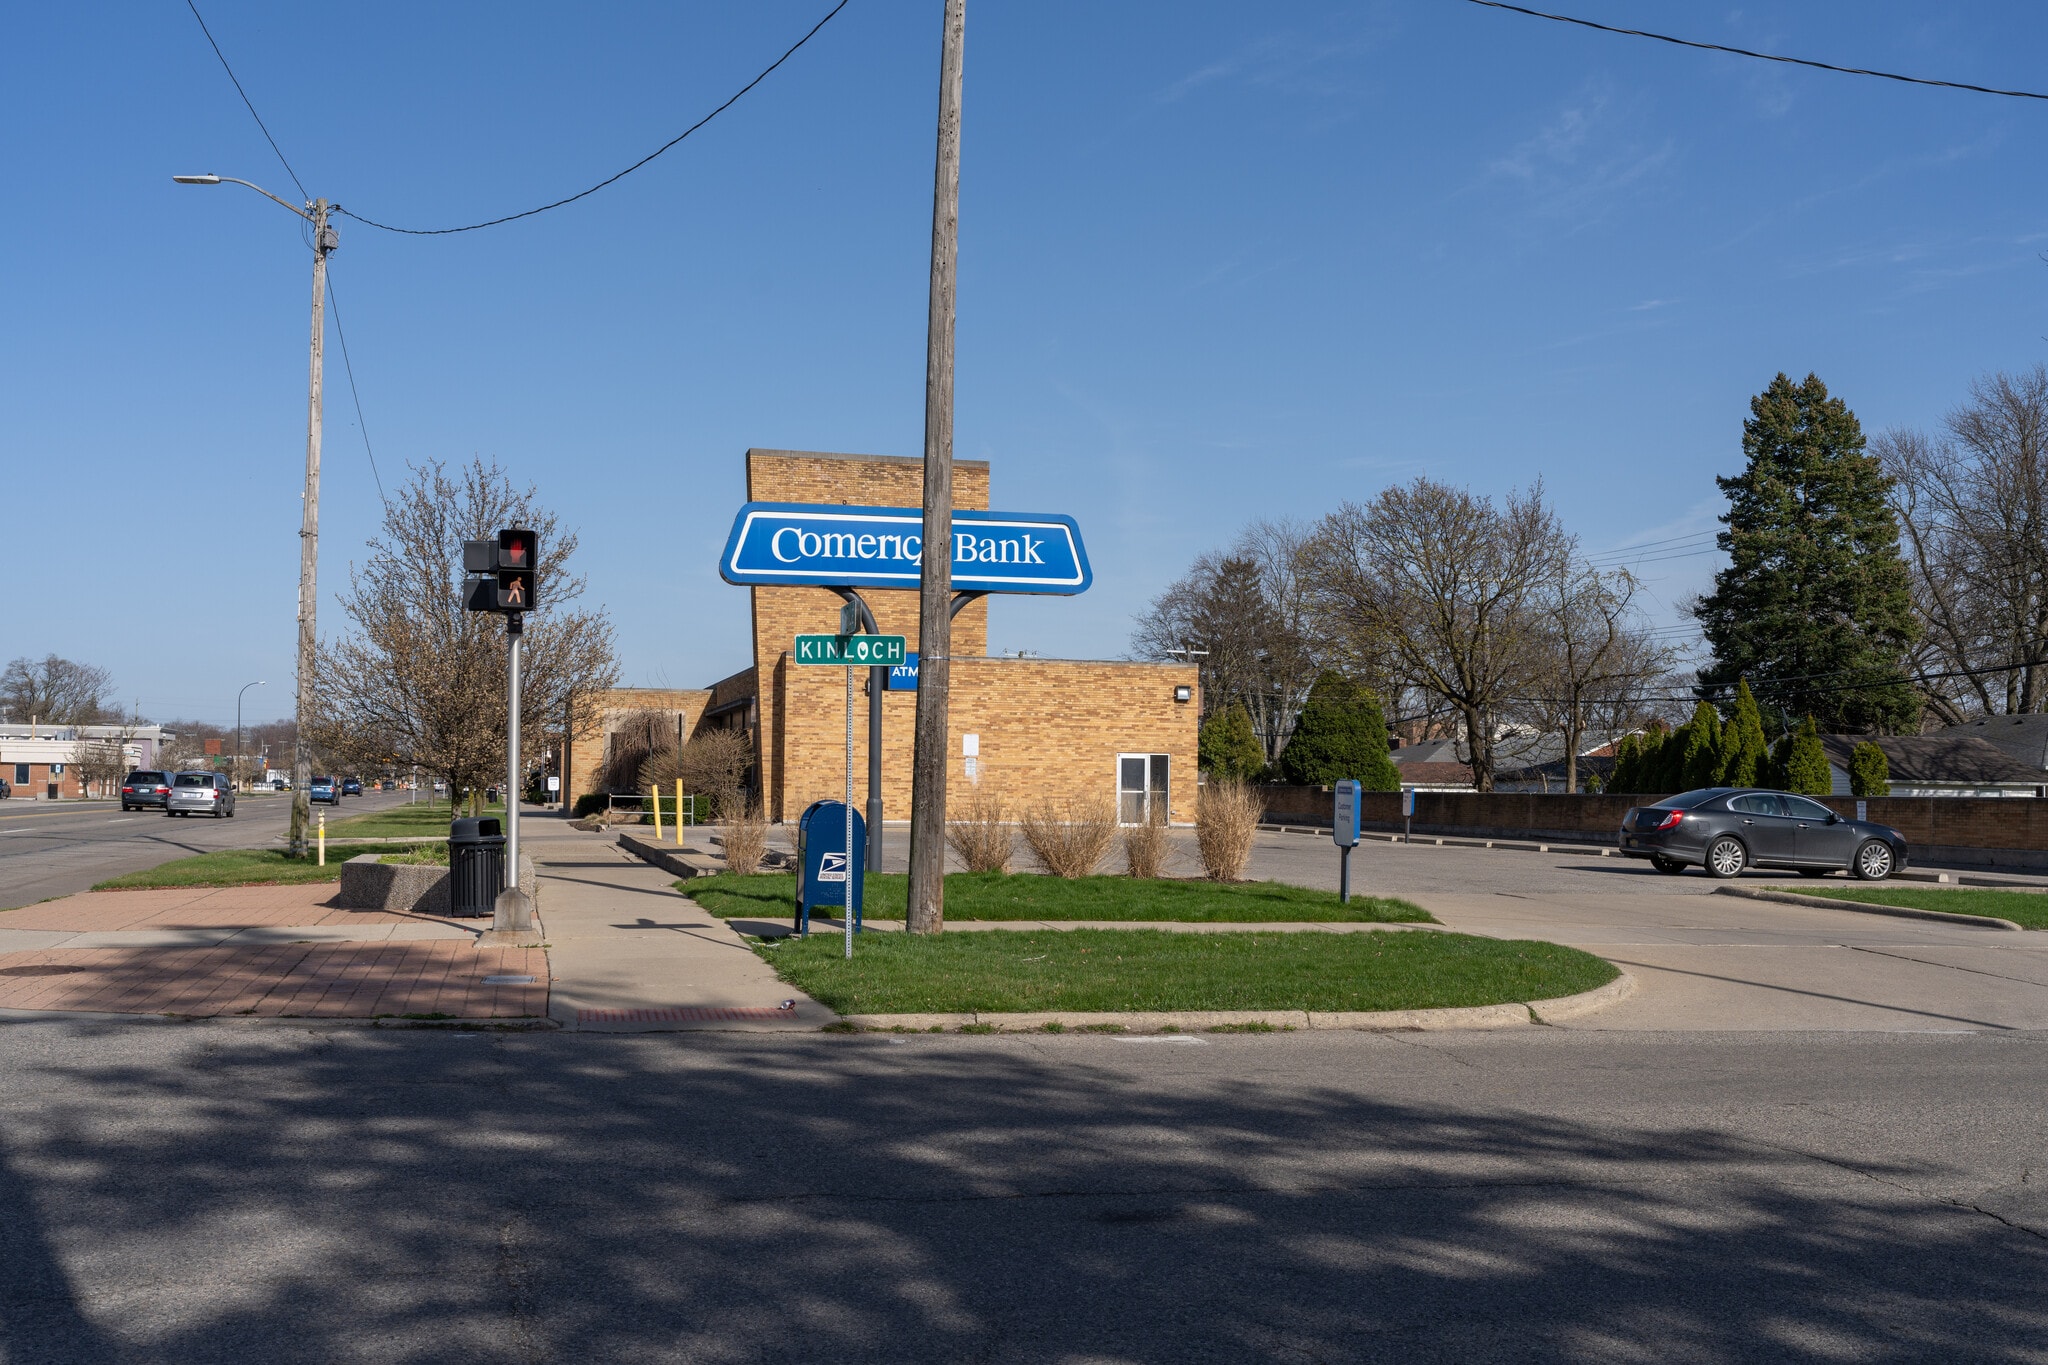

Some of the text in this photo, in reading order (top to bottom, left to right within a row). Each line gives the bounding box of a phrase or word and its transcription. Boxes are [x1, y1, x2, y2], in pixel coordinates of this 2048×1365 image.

[771, 527, 1046, 566] Comeric Bank
[801, 641, 900, 660] KINLOCH
[891, 666, 919, 677] ATM
